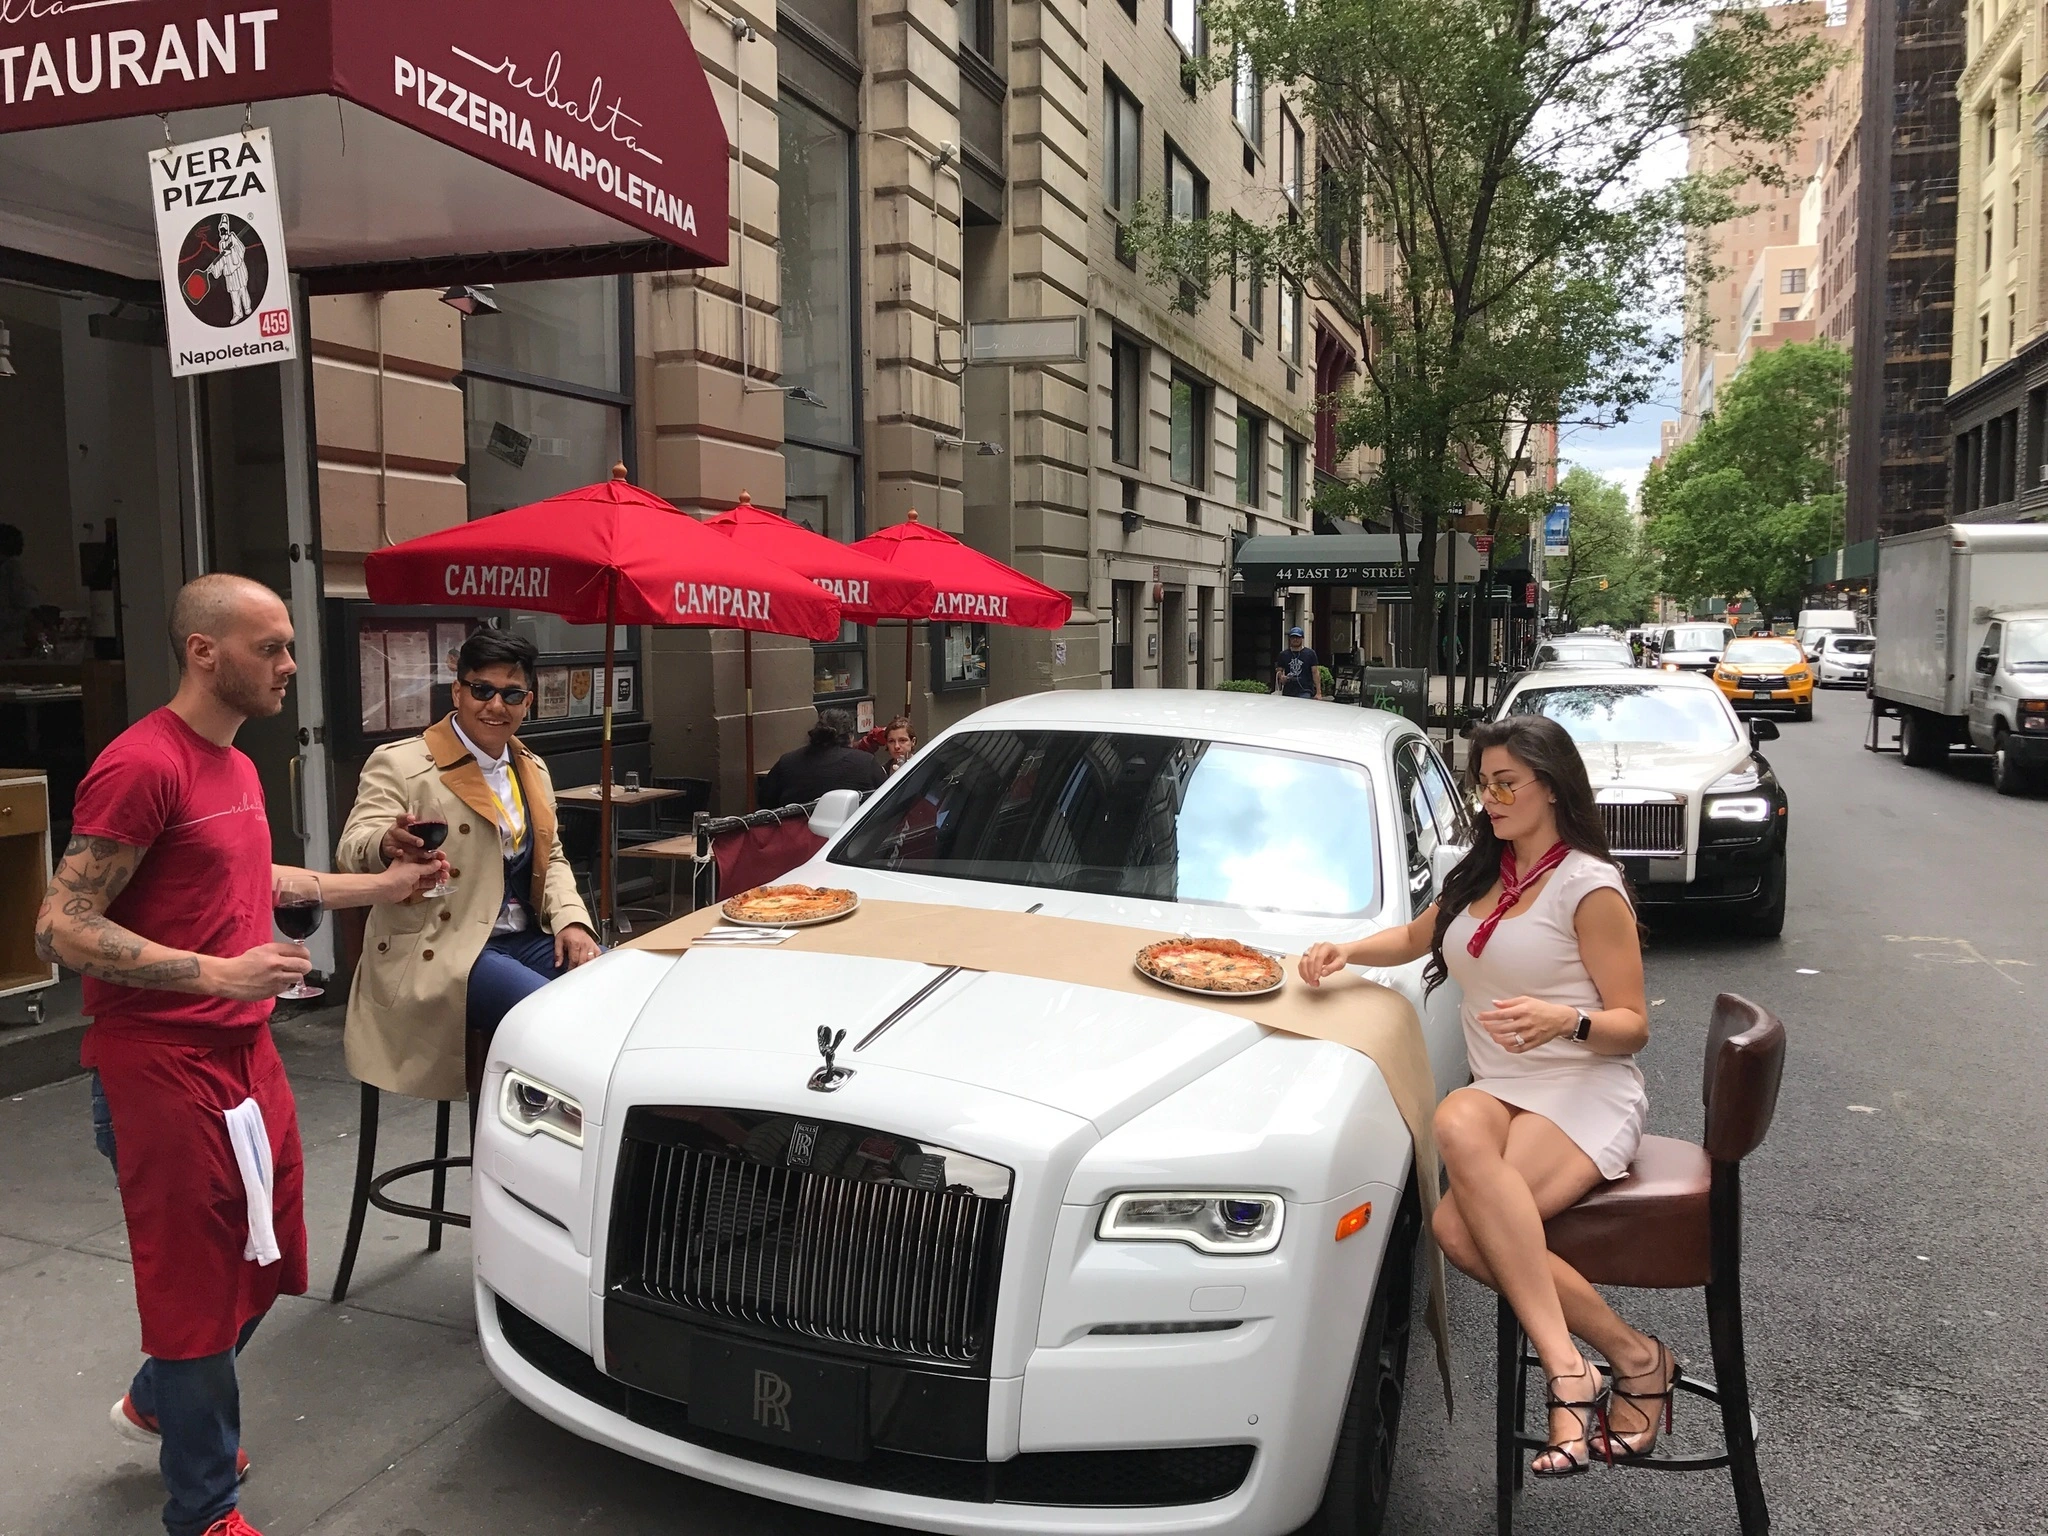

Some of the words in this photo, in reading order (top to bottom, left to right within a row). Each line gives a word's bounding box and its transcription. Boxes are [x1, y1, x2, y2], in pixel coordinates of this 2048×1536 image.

[159, 141, 262, 182] VERA
[394, 55, 537, 158] PIZZERIA
[544, 128, 698, 238] NAPOLETANA
[162, 171, 267, 212] PIZZA
[261, 311, 288, 334] 459
[179, 339, 285, 366] Napoletana
[444, 564, 551, 598] CAMPARI
[1275, 568, 1292, 580] 44
[1296, 568, 1331, 580] EAST
[674, 581, 772, 621] CAMPARI
[812, 579, 870, 605] PARI
[931, 592, 1009, 618] AMPARI
